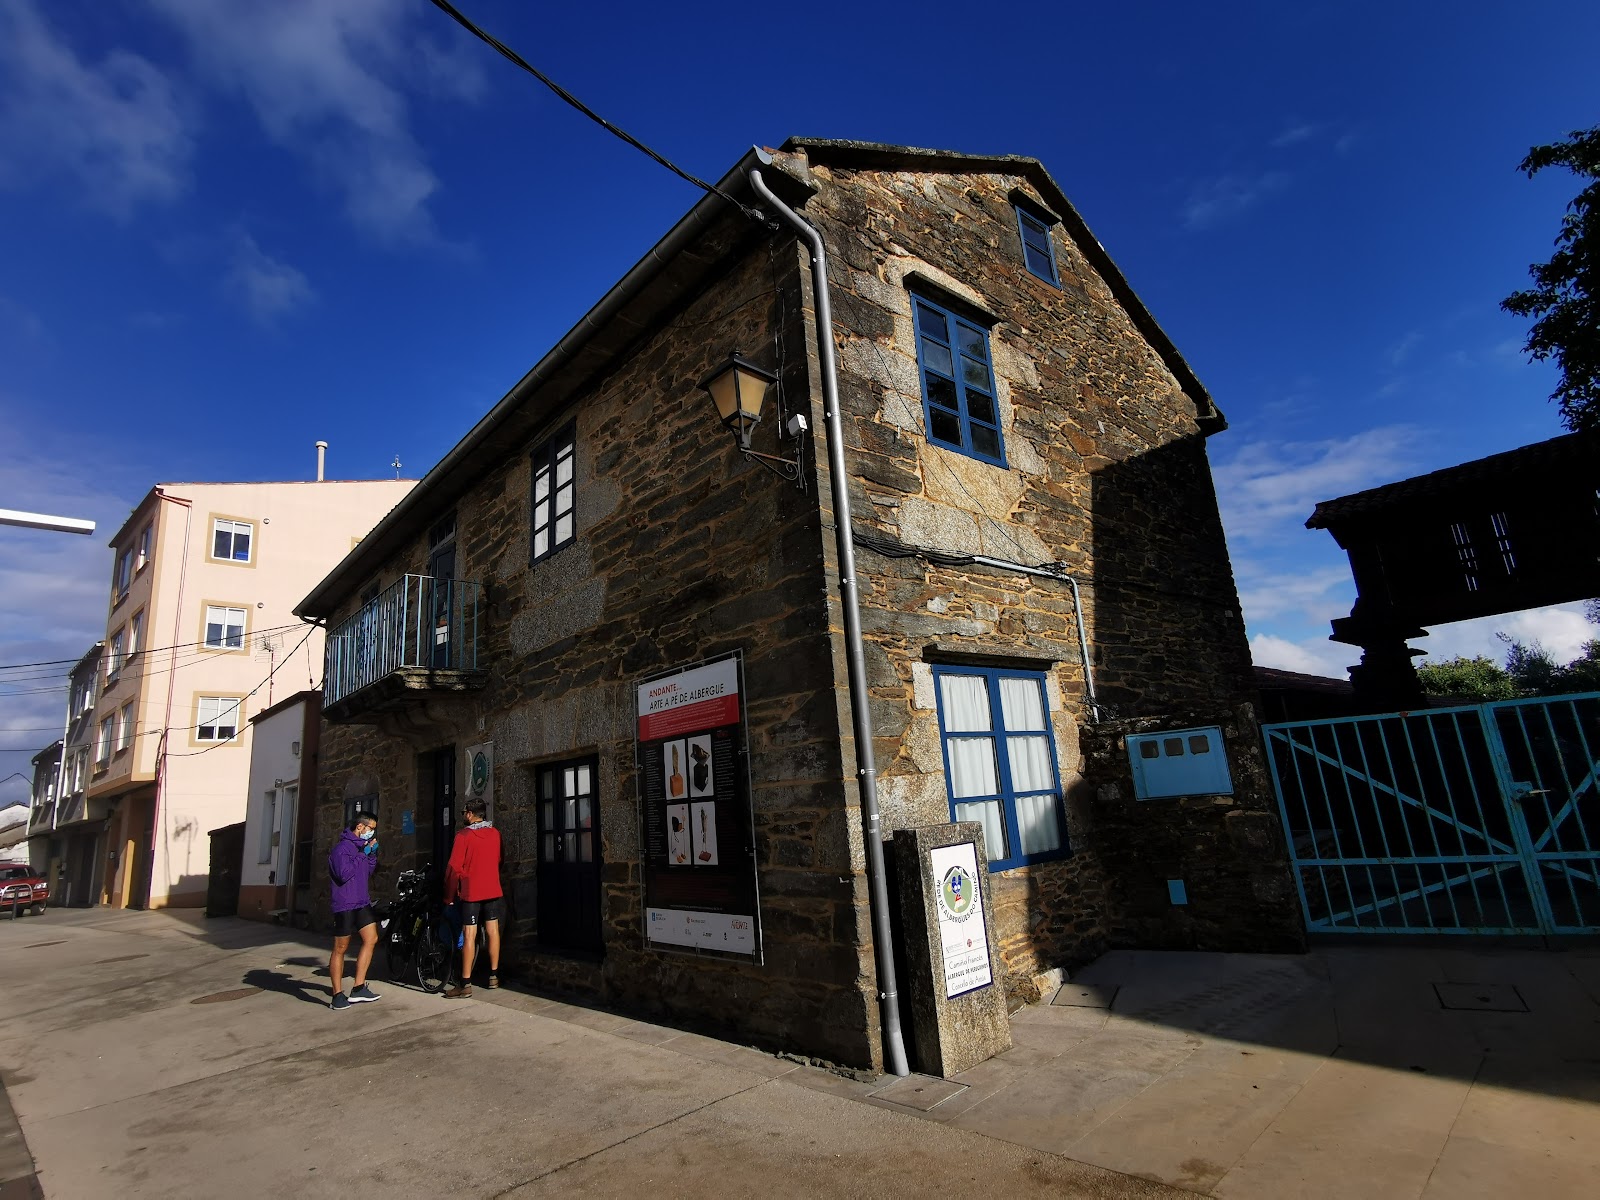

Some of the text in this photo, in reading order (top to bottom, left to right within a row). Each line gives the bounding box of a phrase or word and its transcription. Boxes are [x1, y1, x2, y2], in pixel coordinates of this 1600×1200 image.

[649, 683, 724, 711] ARTE A PÉ DE ALBERGUE
[938, 899, 946, 910] DE
[969, 903, 976, 915] DO
